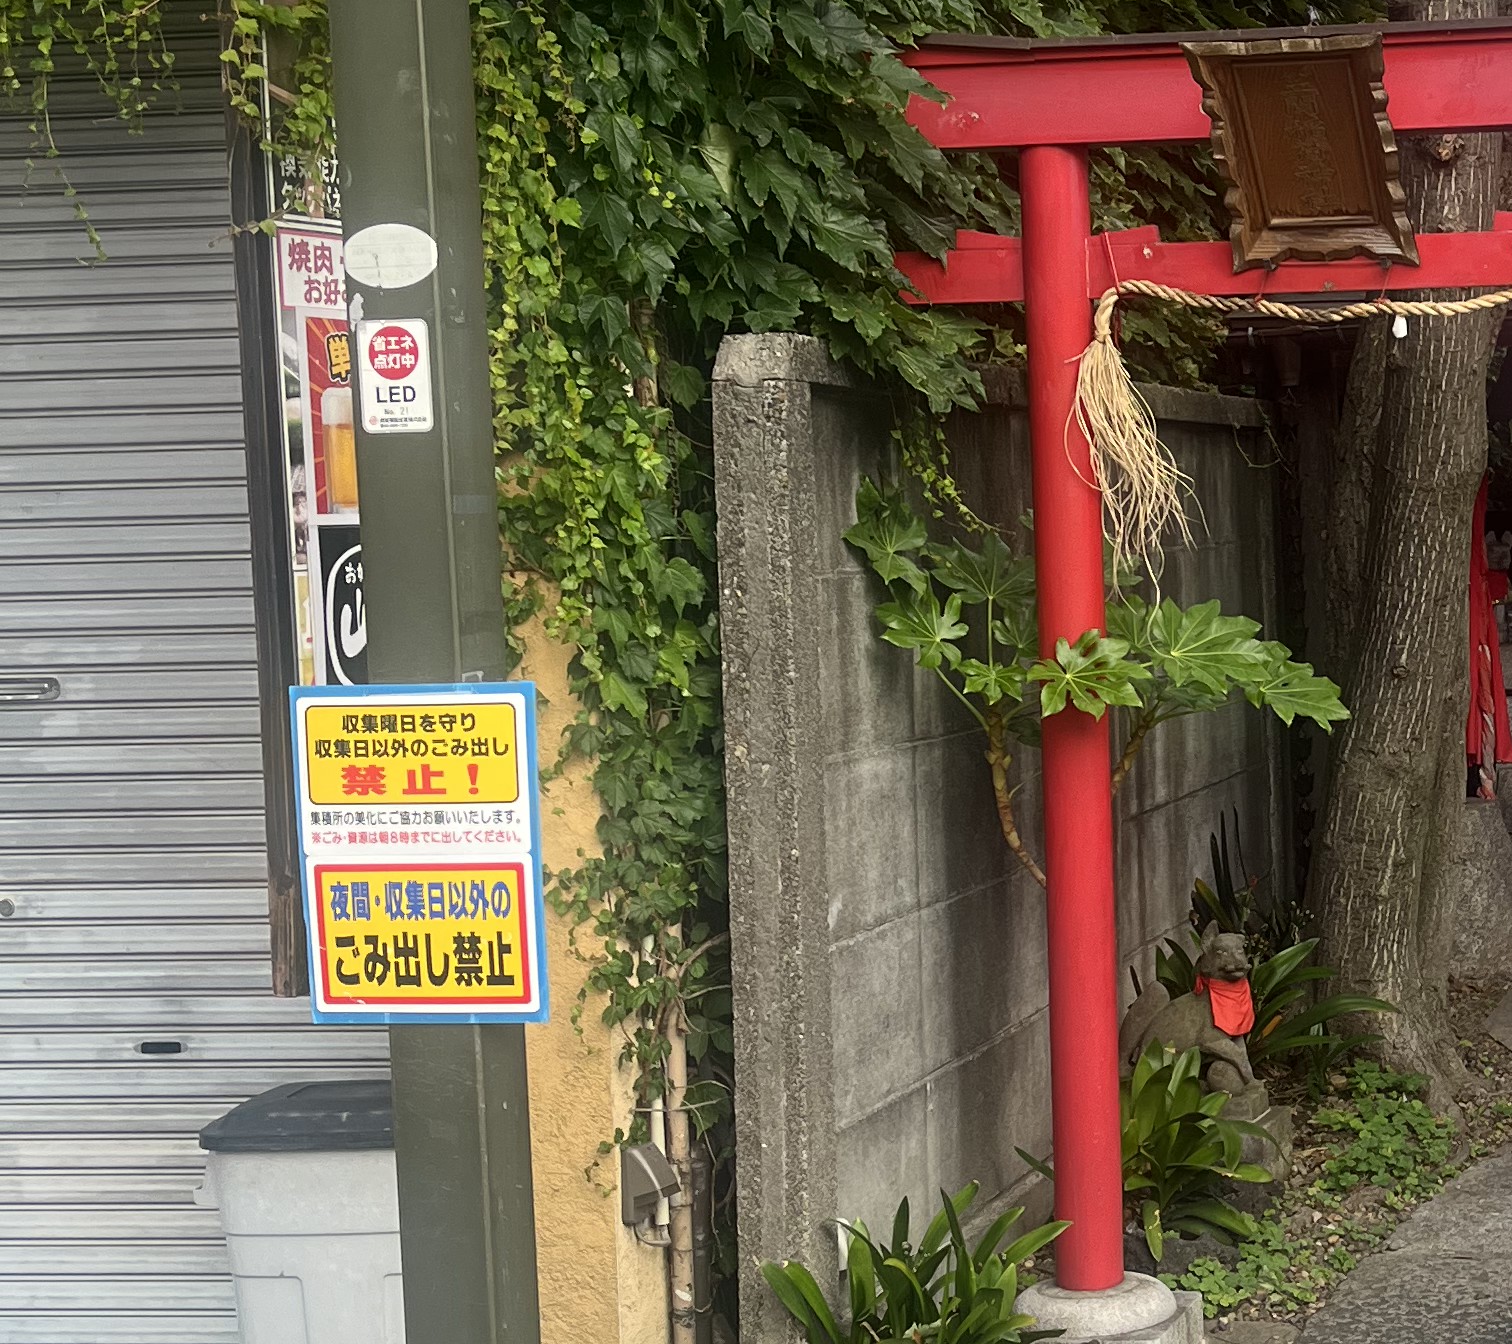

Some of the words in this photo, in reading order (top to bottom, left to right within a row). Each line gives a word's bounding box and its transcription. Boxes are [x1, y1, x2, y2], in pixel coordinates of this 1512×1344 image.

[372, 335, 415, 352] 省エネ
[373, 353, 416, 370] 点灯中
[375, 385, 417, 404] LED
[342, 713, 476, 734] 収集曜日を守り
[314, 737, 509, 759] 収集日以外のごみ出し
[330, 880, 511, 922] 夜間・収集日以外の
[334, 931, 515, 987] ごみ出し禁止
